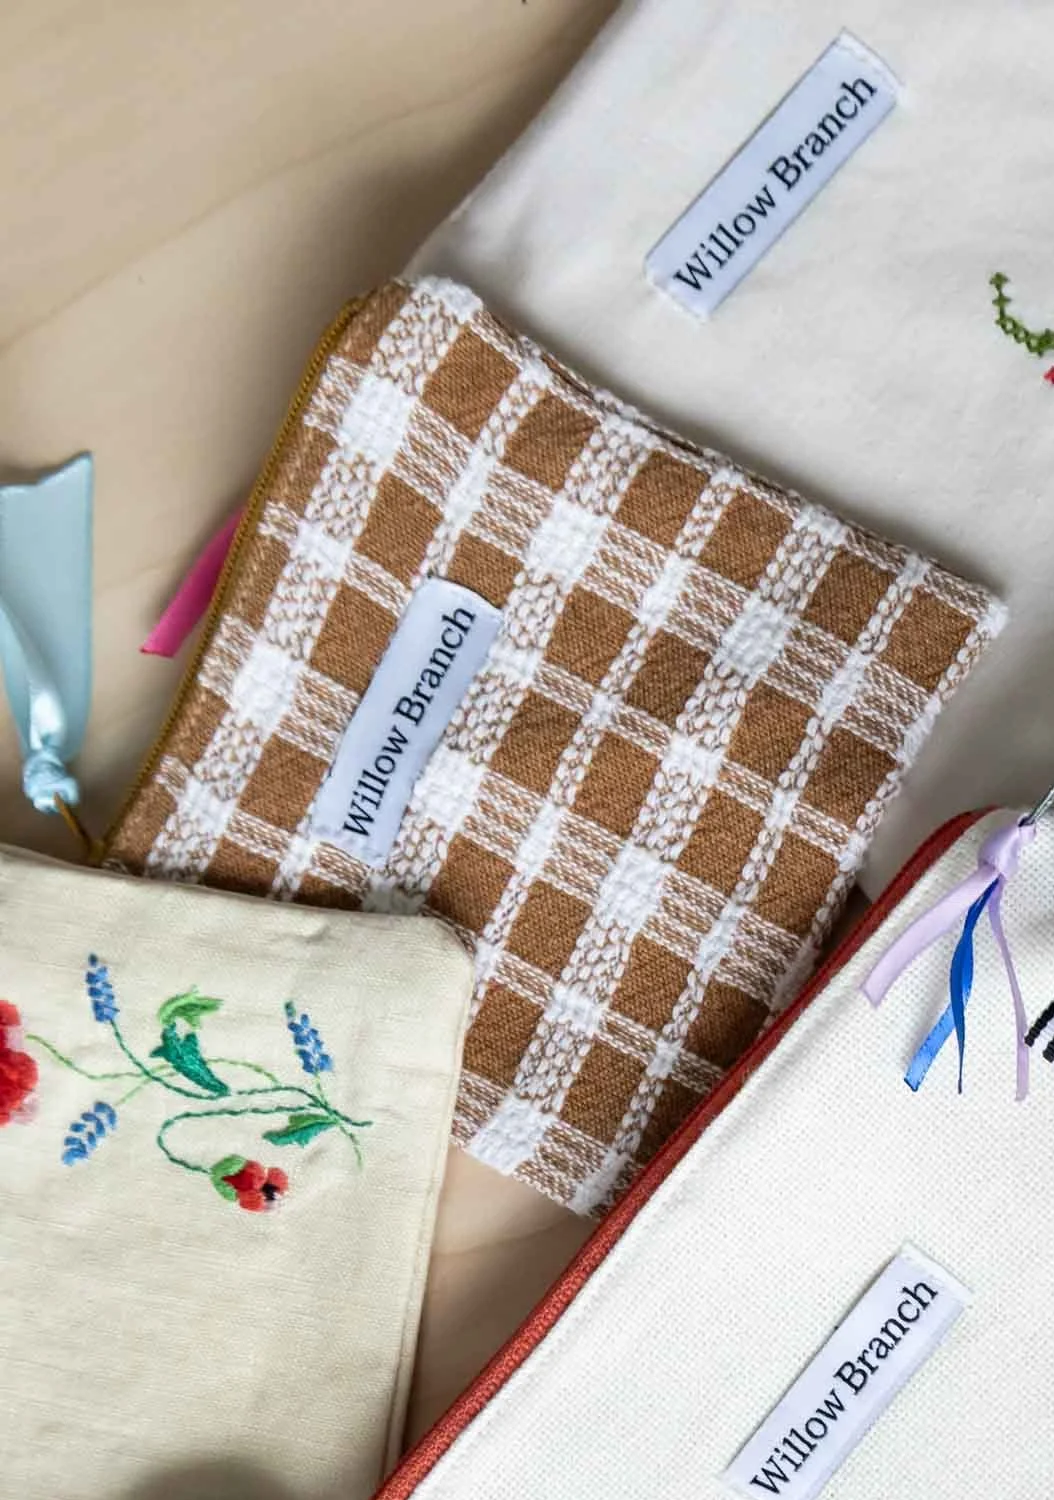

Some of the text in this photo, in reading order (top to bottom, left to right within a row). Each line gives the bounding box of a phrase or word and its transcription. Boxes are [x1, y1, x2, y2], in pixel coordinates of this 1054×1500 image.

[673, 79, 877, 290] Willow Branch
[343, 608, 476, 836] Willow Branch
[750, 1283, 938, 1494] Willow Branch
